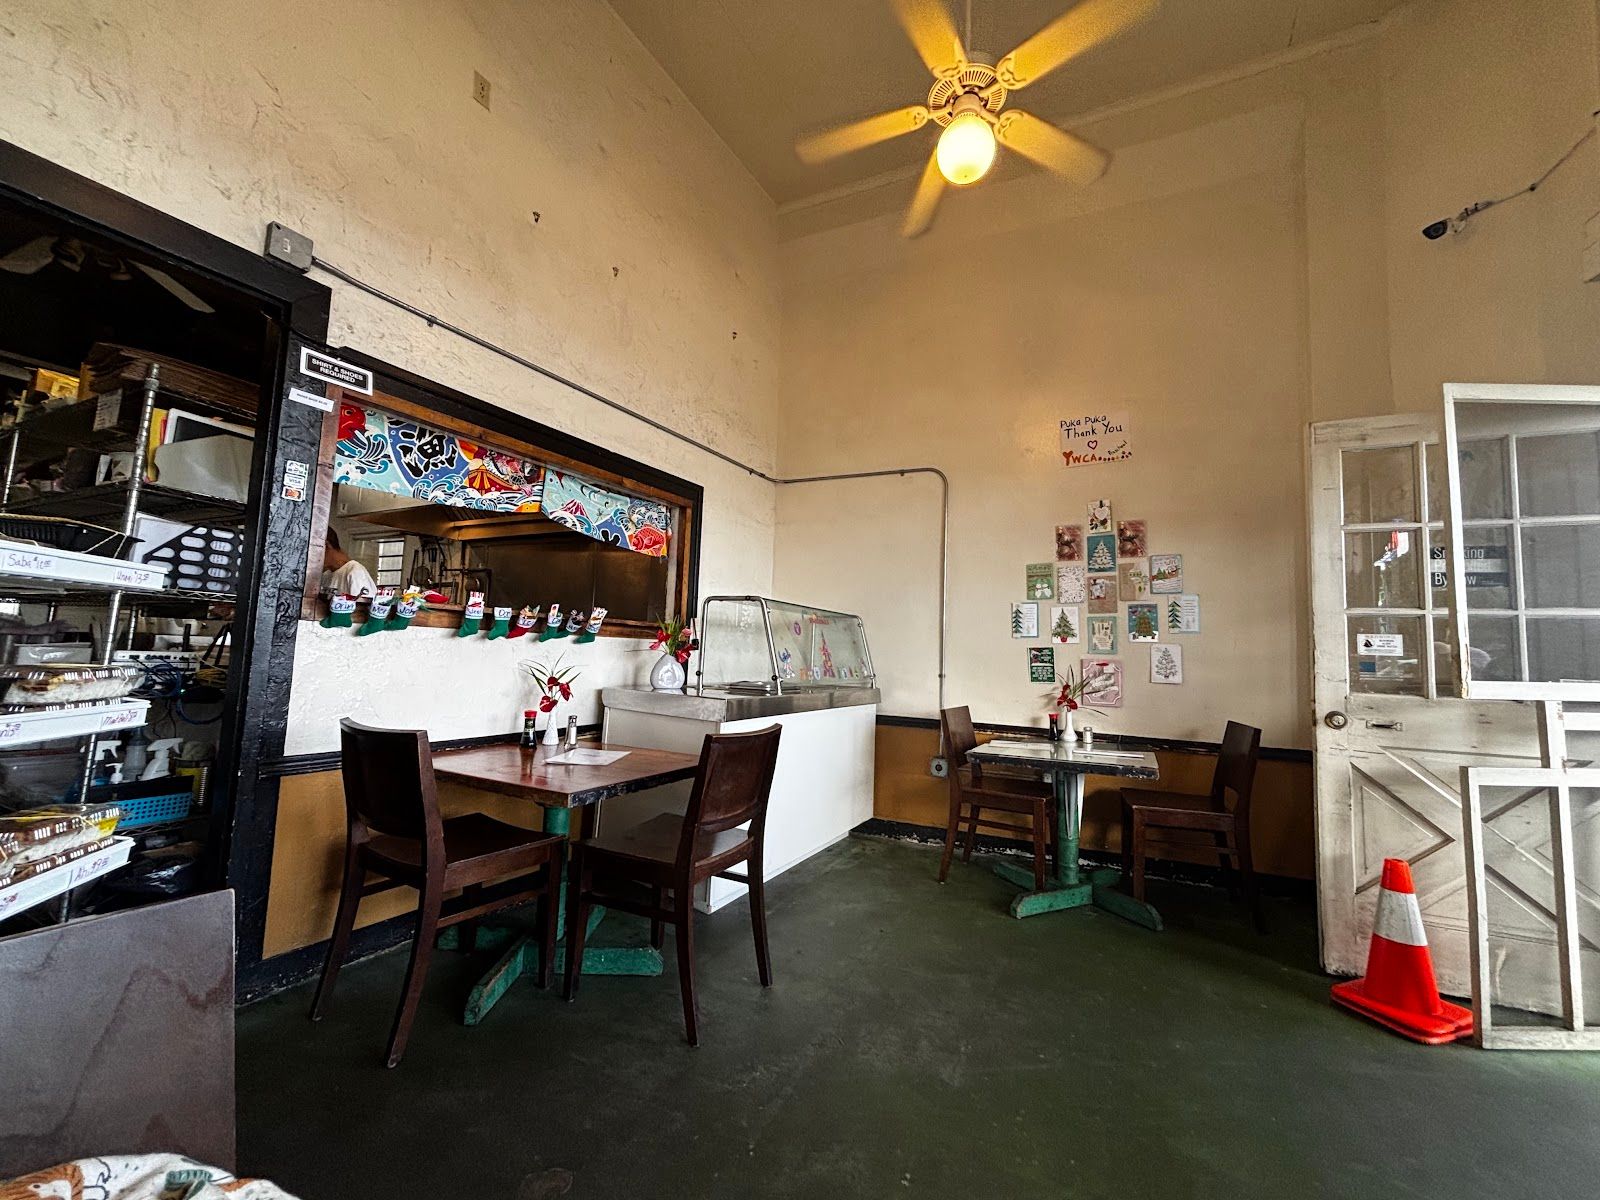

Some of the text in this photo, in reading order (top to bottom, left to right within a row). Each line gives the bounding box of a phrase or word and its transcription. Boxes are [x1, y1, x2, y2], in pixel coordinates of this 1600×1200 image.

[311, 358, 334, 370] SHIRT
[340, 368, 364, 381] SHOES
[319, 366, 356, 383] REQUIRED
[1064, 421, 1123, 439] Thank You
